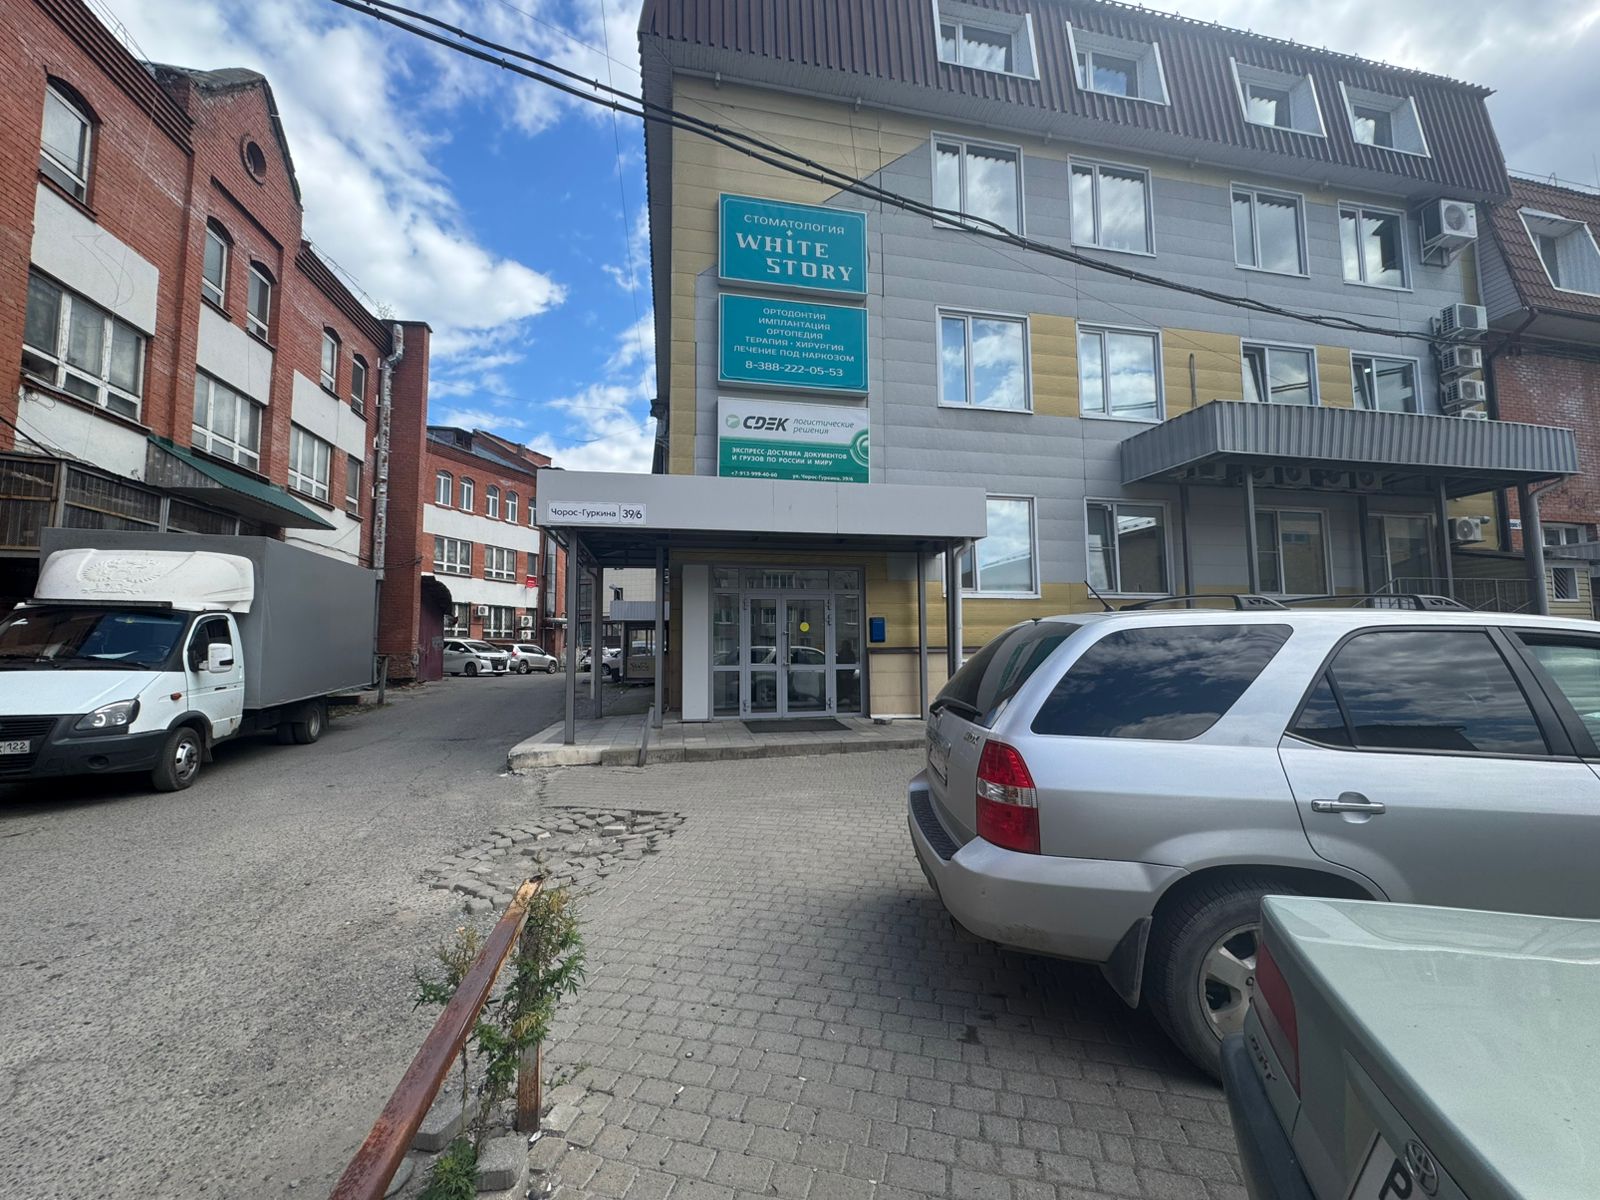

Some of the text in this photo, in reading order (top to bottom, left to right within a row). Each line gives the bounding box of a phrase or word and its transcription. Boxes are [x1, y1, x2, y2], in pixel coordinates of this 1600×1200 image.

[744, 214, 845, 235] СТОМАТОЛОГИЯ
[736, 231, 829, 258] WHITE
[766, 257, 853, 281] STORY
[763, 307, 826, 320] ОРТОДОНТИЯ
[758, 317, 831, 331] ИМПЛАНТАЦИЯ
[766, 328, 823, 340] ОРТОПЕДИЯ
[745, 336, 844, 352] ТЕРАПИЯ ХИРУРГИЯ
[734, 345, 854, 363] ЛЕЧЕНИЕ ПОД НАРКОЗОМ
[745, 360, 843, 377] 8-388-222-05-53
[743, 415, 789, 432] CDEK
[793, 418, 855, 429] логистические
[793, 426, 829, 435] решения
[731, 447, 847, 460] ЭКСПРЕСС-ДОСТАВКА ДОКУМЕНТОВ
[551, 508, 643, 519] Чорос-Гуркина 39/6
[7, 742, 27, 750] 122
